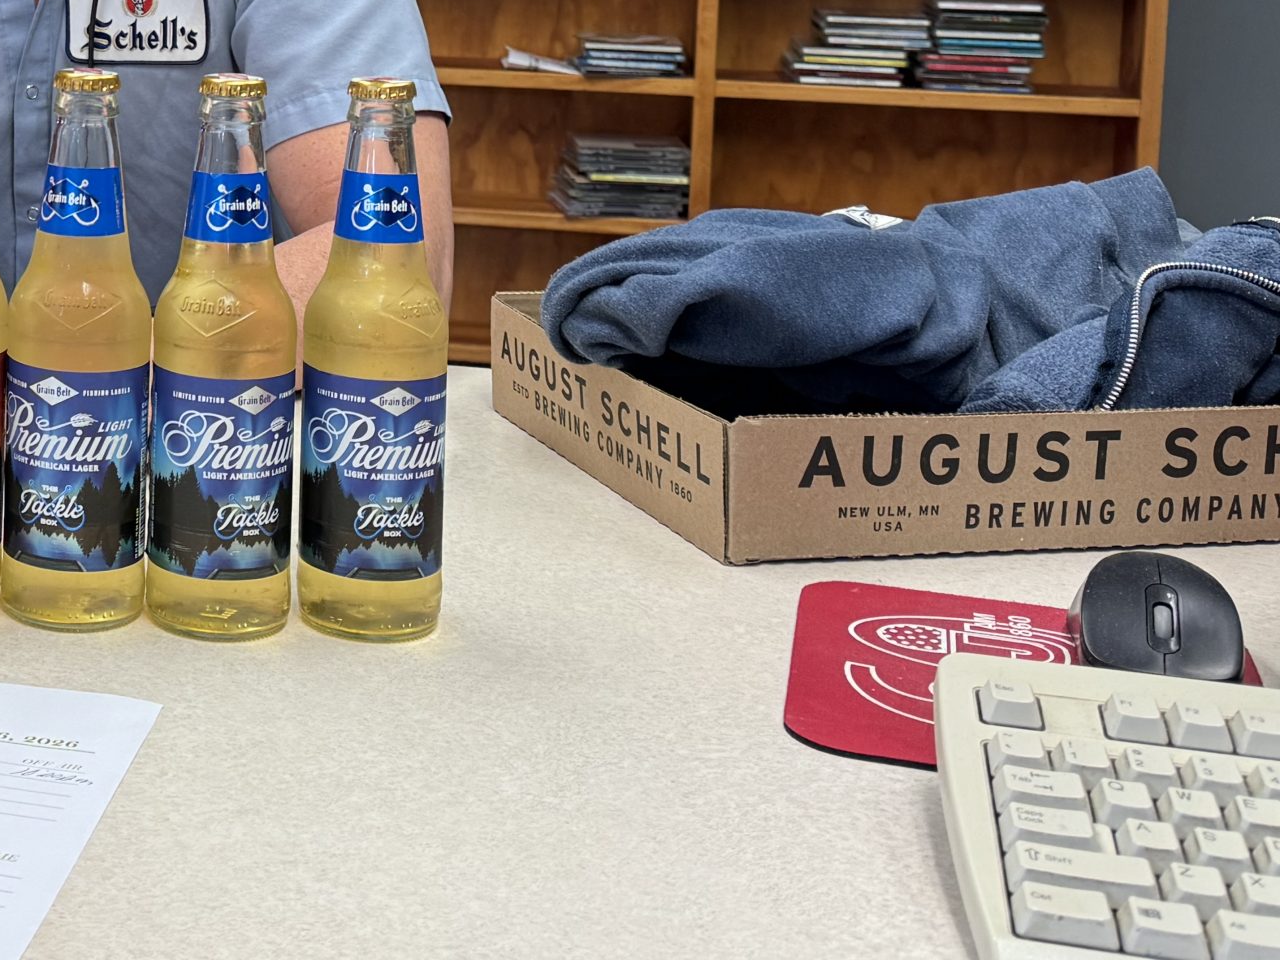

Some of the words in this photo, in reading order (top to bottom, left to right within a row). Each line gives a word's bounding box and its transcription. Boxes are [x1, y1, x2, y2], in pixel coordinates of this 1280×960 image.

[81, 17, 199, 54] Schell's
[48, 190, 67, 204] Grain
[69, 192, 87, 206] Belt
[219, 199, 245, 212] Grain
[247, 198, 260, 212] Belt
[363, 198, 390, 213] Grain
[392, 200, 407, 213] Belt
[179, 294, 213, 315] Grain
[36, 383, 55, 395] Grain
[56, 386, 71, 397] Belt
[173, 390, 196, 401] LIMITED
[198, 395, 225, 404] EDITION
[238, 396, 258, 406] Grain
[259, 393, 272, 405] Belt
[339, 393, 366, 403] EDITION
[379, 396, 400, 407] Grain
[401, 396, 415, 407] Belt
[501, 331, 586, 409] AUGUST
[601, 390, 710, 485] SCHELL
[6, 391, 133, 462] Premium
[98, 418, 133, 433] LIGHT
[513, 380, 529, 399] ESTD
[534, 390, 589, 442] BREWING
[597, 430, 663, 489] COMPANY
[670, 480, 692, 503] 1860
[29, 458, 70, 472] AMERICAN
[72, 463, 99, 472] LAGER
[798, 430, 1121, 488] AUGUST
[203, 471, 228, 480] LIGHT
[229, 471, 270, 480] AMERICAN
[271, 465, 287, 476] LAGER
[344, 470, 368, 480] LIGHT
[370, 471, 413, 480] AMERICAN
[415, 469, 434, 479] LAGER
[42, 484, 58, 493] THE
[21, 489, 84, 519] Tackle
[838, 505, 870, 519] NEW
[877, 506, 912, 518] ULM,
[919, 504, 940, 517] MN
[217, 501, 280, 531] Tackle
[357, 503, 424, 530] Tackle
[965, 499, 1116, 529] BREWING
[40, 518, 57, 526] BOX
[873, 521, 904, 532] USA
[1008, 615, 1033, 637] 860
[24, 736, 80, 749] 2026
[1107, 781, 1125, 792] Q
[1176, 790, 1193, 803] W
[1243, 798, 1259, 810] E
[1136, 822, 1152, 833] A
[1202, 830, 1217, 842] S
[1180, 867, 1195, 878] Z
[1248, 875, 1266, 888] X
